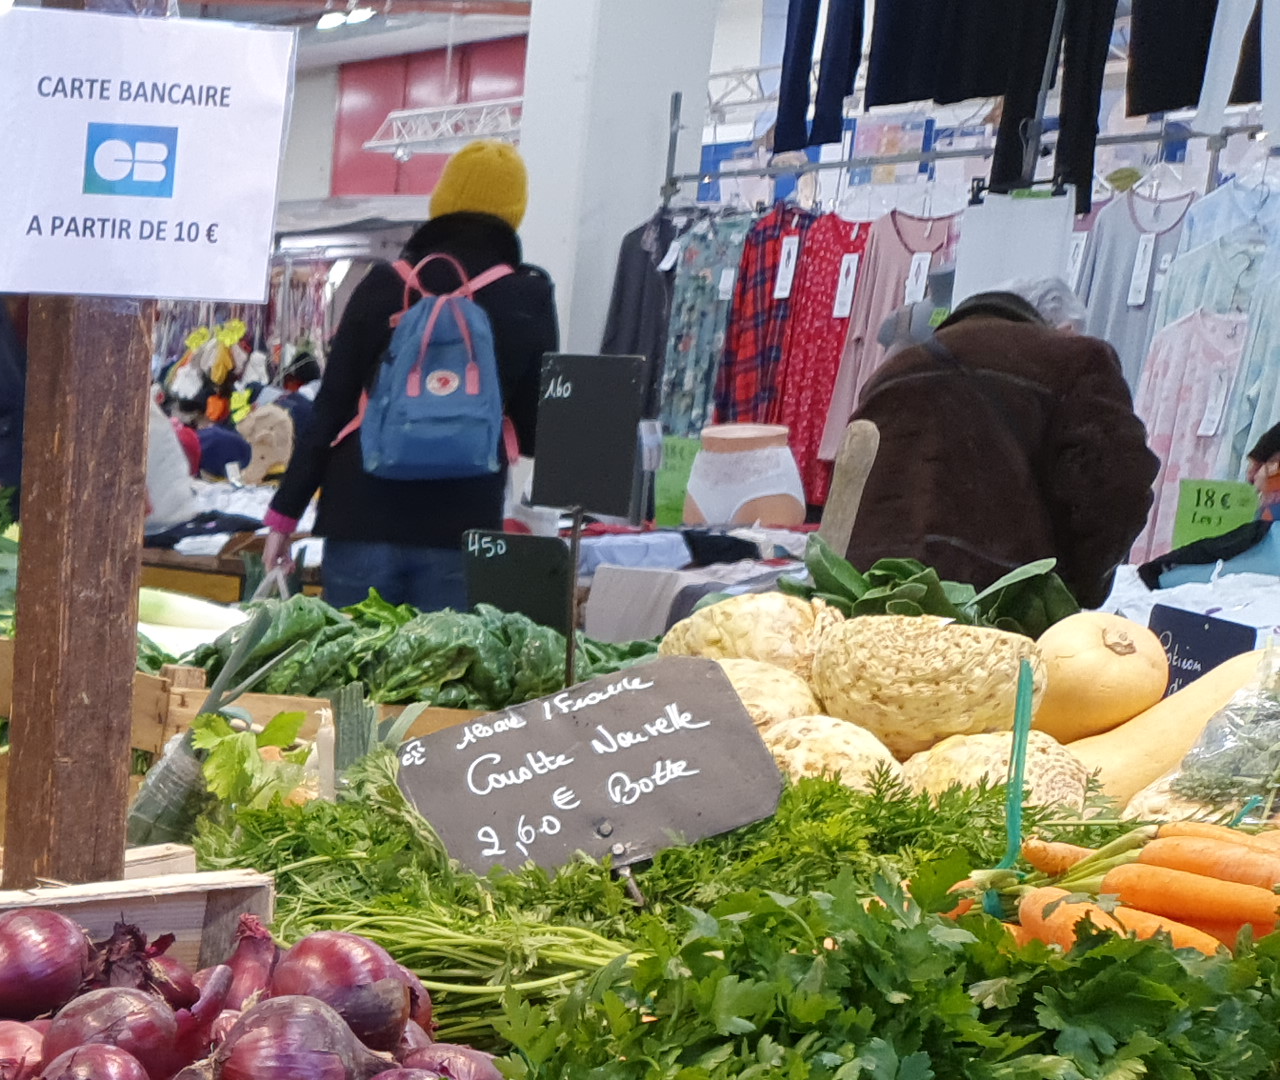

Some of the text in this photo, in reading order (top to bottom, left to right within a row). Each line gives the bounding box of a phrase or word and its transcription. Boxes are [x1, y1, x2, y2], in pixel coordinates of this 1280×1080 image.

[37, 75, 231, 108] CARTE BANCAIRE
[93, 139, 169, 182] CB
[25, 214, 219, 244] A PARTIR DE 10 €
[607, 757, 701, 806] Botte
